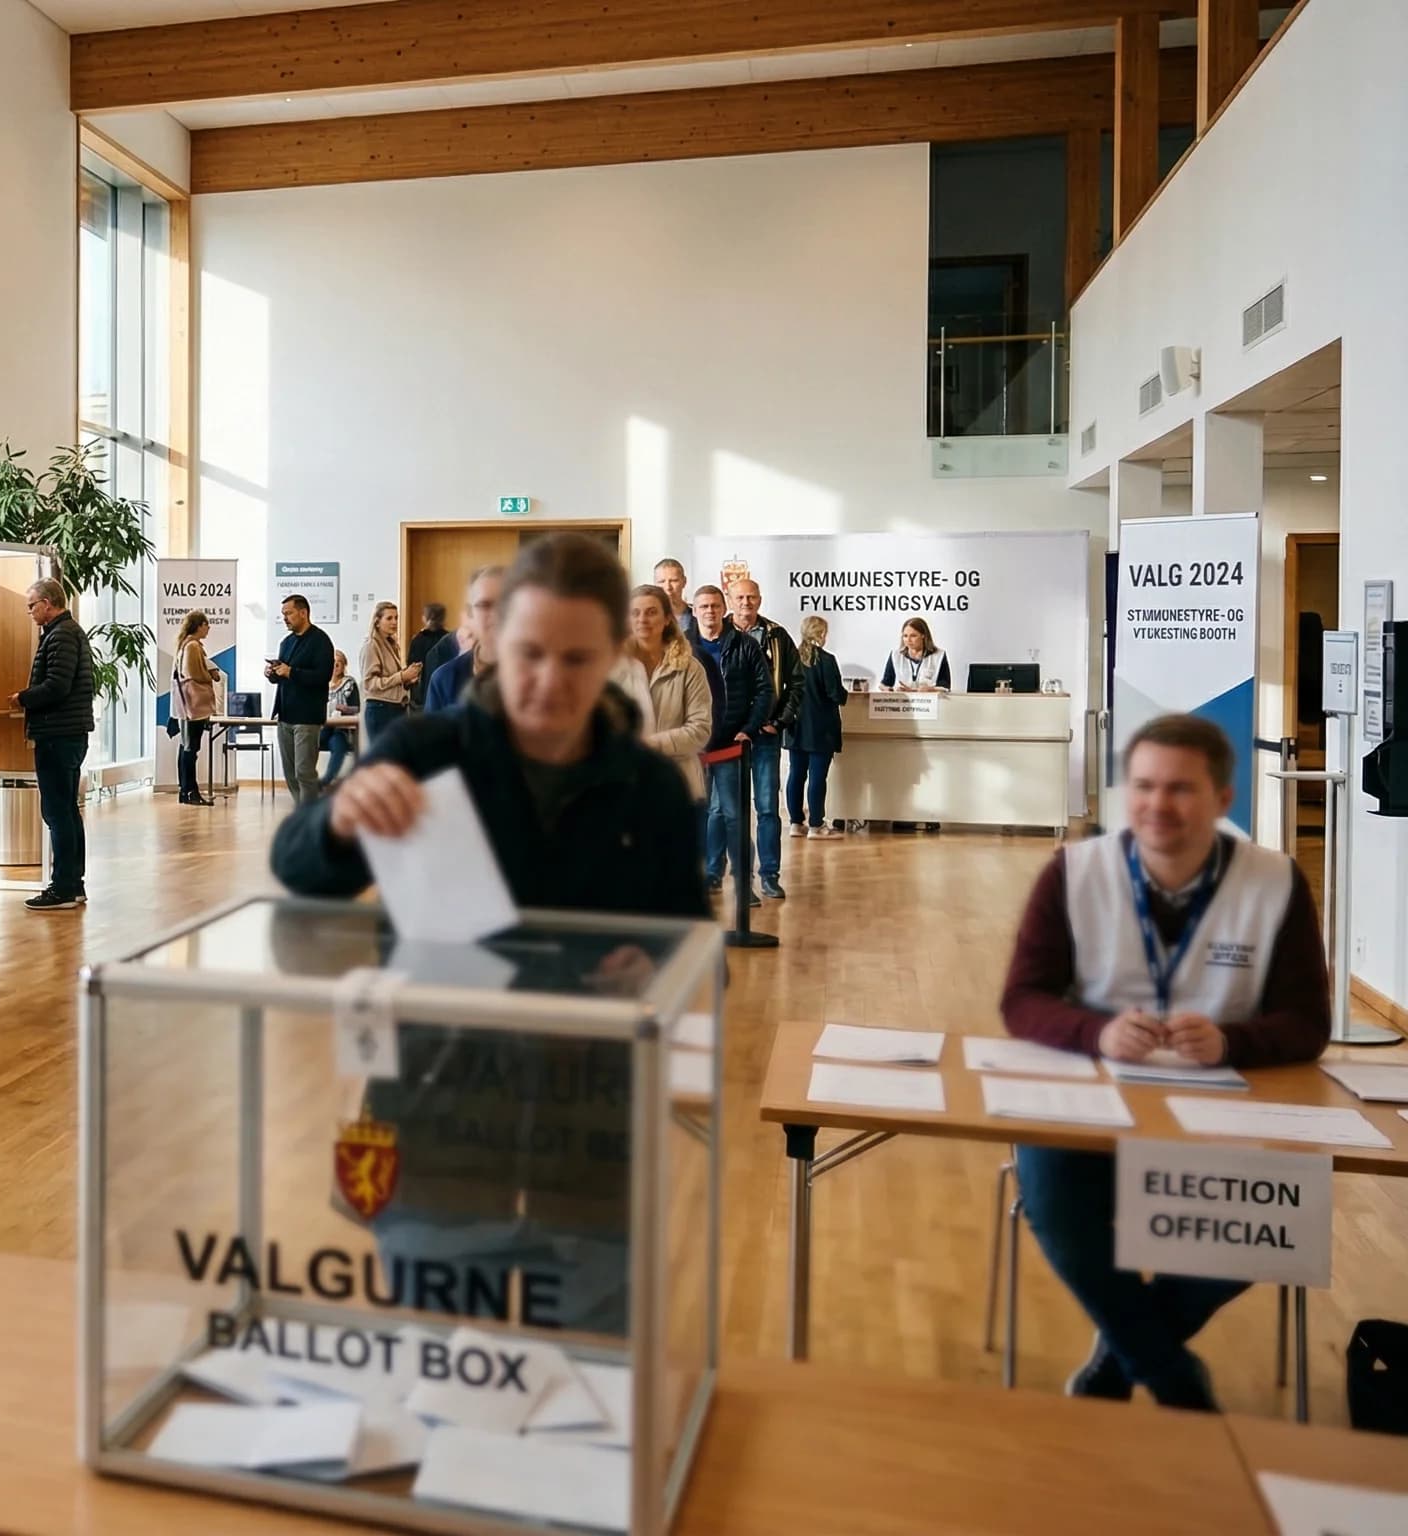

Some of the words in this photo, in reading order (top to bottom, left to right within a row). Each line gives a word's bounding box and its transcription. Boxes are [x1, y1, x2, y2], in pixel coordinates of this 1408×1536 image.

[789, 571, 949, 588] KOMMUNESTYRE-
[954, 570, 981, 587] OG
[1129, 563, 1182, 587] VALG
[1189, 561, 1244, 586] 2024
[163, 583, 197, 597] VALG
[199, 583, 232, 597] 2024
[800, 595, 969, 612] FYLKESTINGSVALG
[1199, 627, 1236, 641] BOOTH
[1144, 1170, 1301, 1208] ELECTION
[1149, 1213, 1296, 1250] OFFICIAL
[175, 1228, 564, 1330] VALGURNE
[206, 1310, 404, 1374] BALLOT
[418, 1340, 532, 1394] BOX
